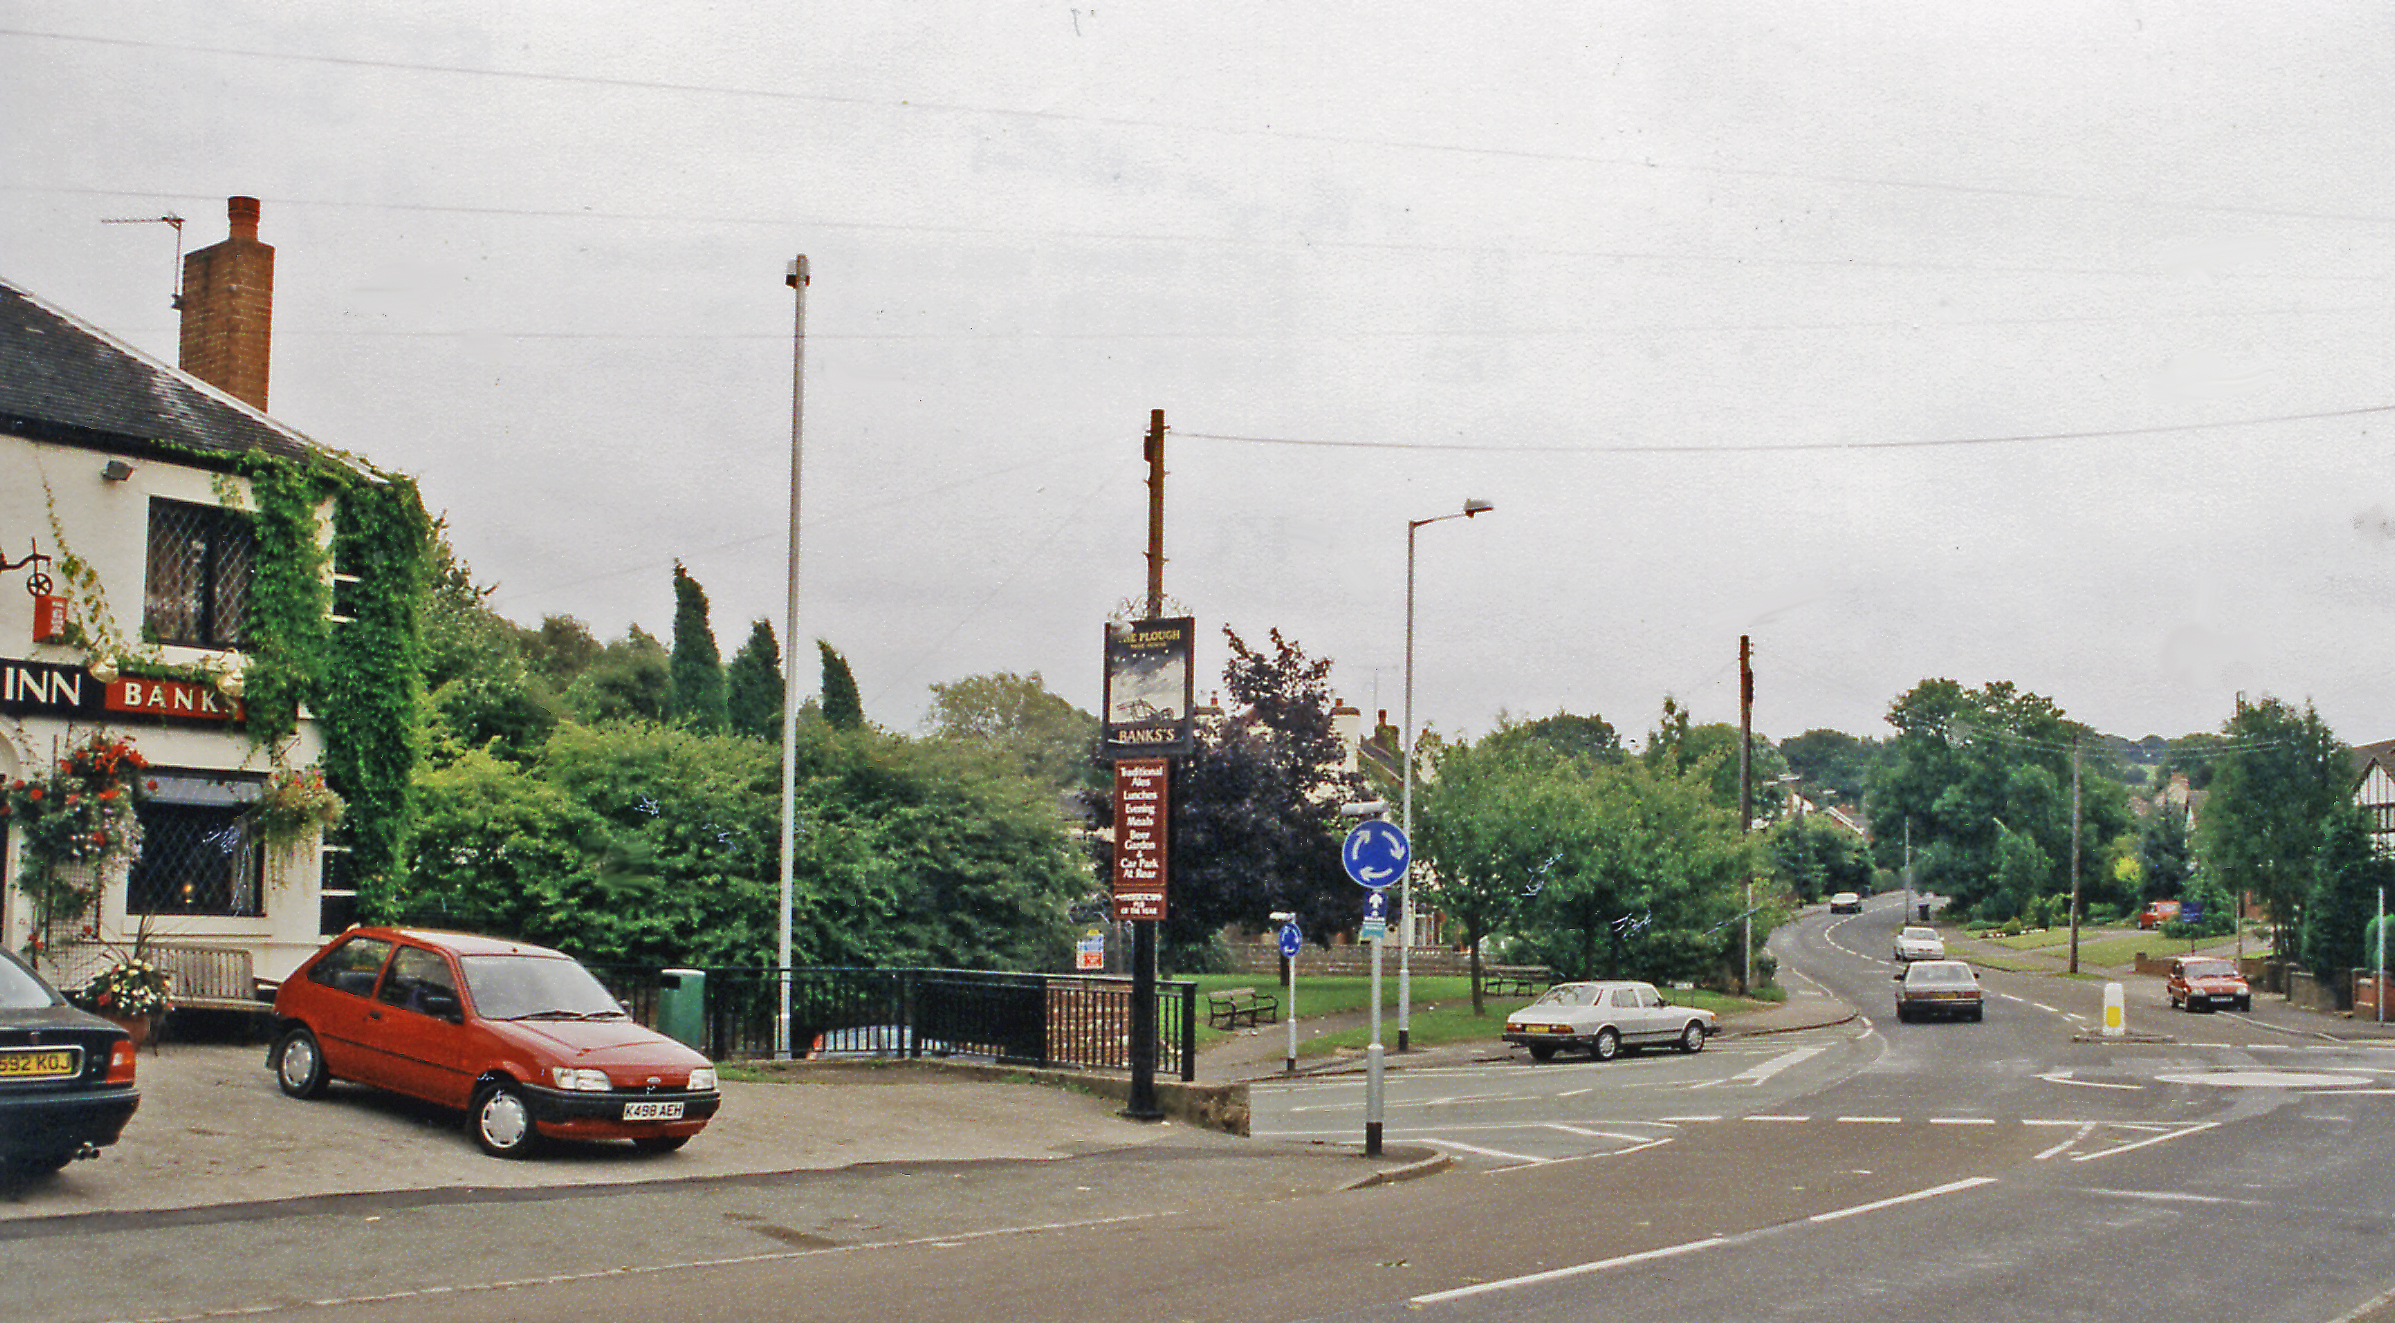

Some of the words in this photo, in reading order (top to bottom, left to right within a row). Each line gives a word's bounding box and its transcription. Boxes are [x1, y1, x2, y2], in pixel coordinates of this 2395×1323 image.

[1139, 629, 1181, 643] PLOUGH
[4, 667, 81, 707] INN
[1119, 728, 1175, 743] BANKS'S
[1120, 766, 1163, 777] Traditional
[1131, 777, 1151, 787] Ales
[1123, 790, 1158, 801] Lunches
[1124, 803, 1156, 816] Evening
[1126, 816, 1154, 827] Meals
[1129, 829, 1151, 841] Beer
[1124, 840, 1157, 851] Garden
[1120, 857, 1137, 869] Car
[1138, 857, 1159, 869] Park
[1123, 868, 1135, 879] At
[1136, 868, 1157, 879] Rear
[37, 1055, 71, 1070] KOJ
[659, 1103, 683, 1117] AEH
